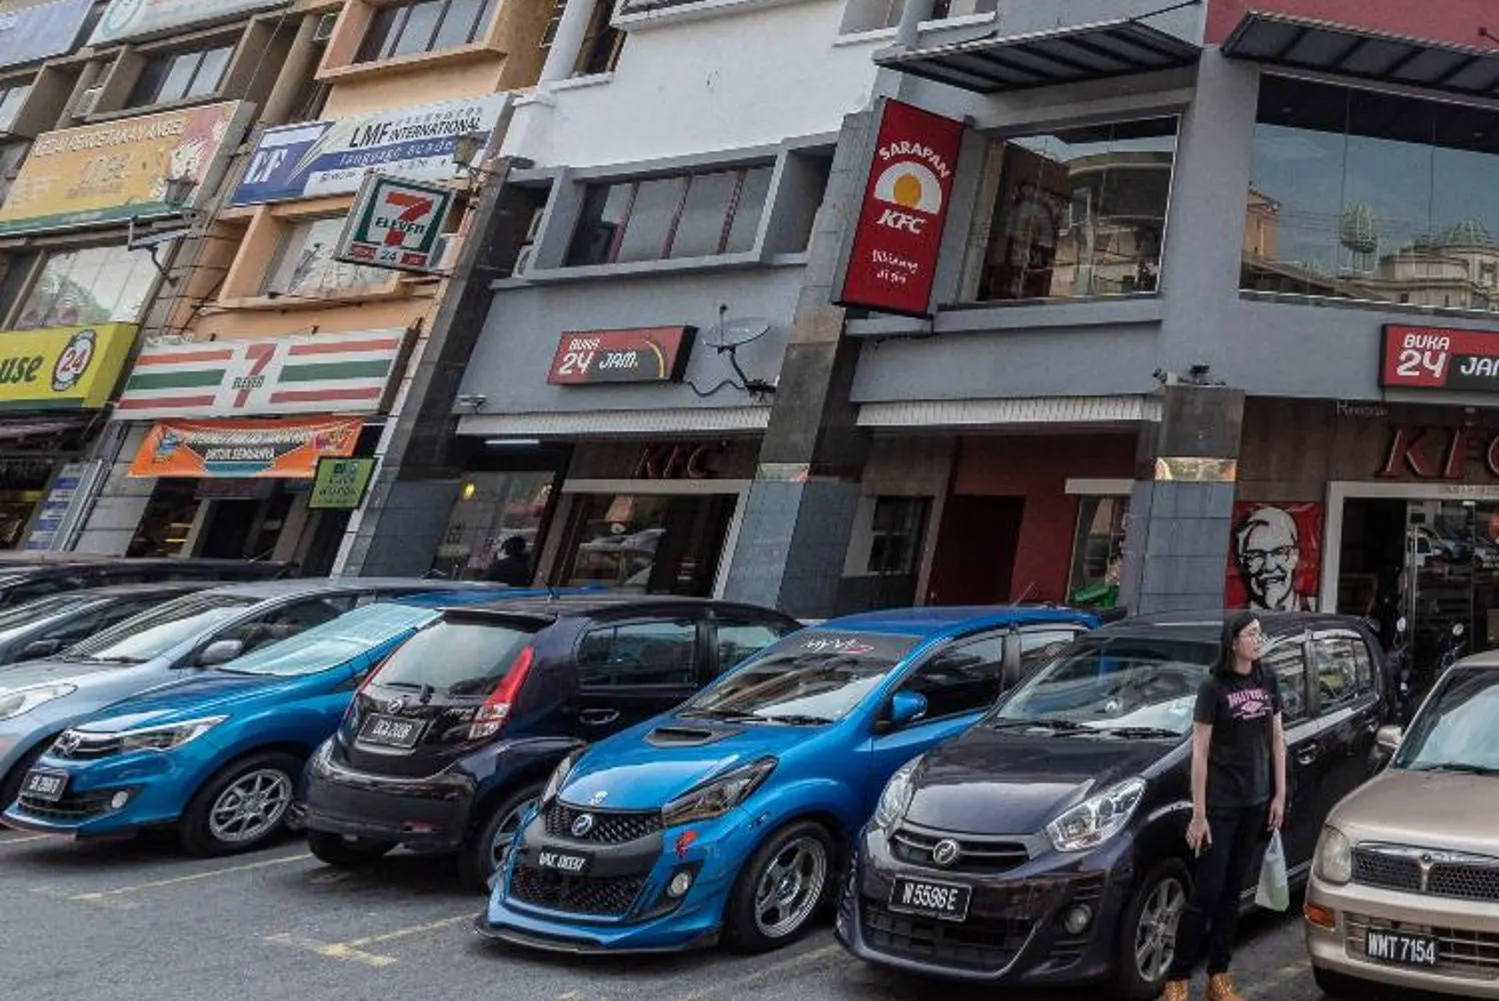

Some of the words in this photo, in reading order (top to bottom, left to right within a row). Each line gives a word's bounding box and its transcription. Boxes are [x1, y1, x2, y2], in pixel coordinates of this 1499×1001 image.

[349, 121, 392, 149] LMF
[388, 117, 481, 142] INTERNATIONAL
[879, 140, 951, 179] SARAPAN
[384, 191, 434, 247] 7
[876, 208, 929, 235] KFC
[568, 338, 602, 351] BUKA
[1404, 334, 1451, 350] BUKA
[232, 343, 278, 408] 7
[558, 352, 593, 375] 24
[599, 351, 638, 370] JAM
[1396, 350, 1447, 378] 24
[1368, 932, 1398, 959] WMT
[1400, 937, 1437, 965] 7154
